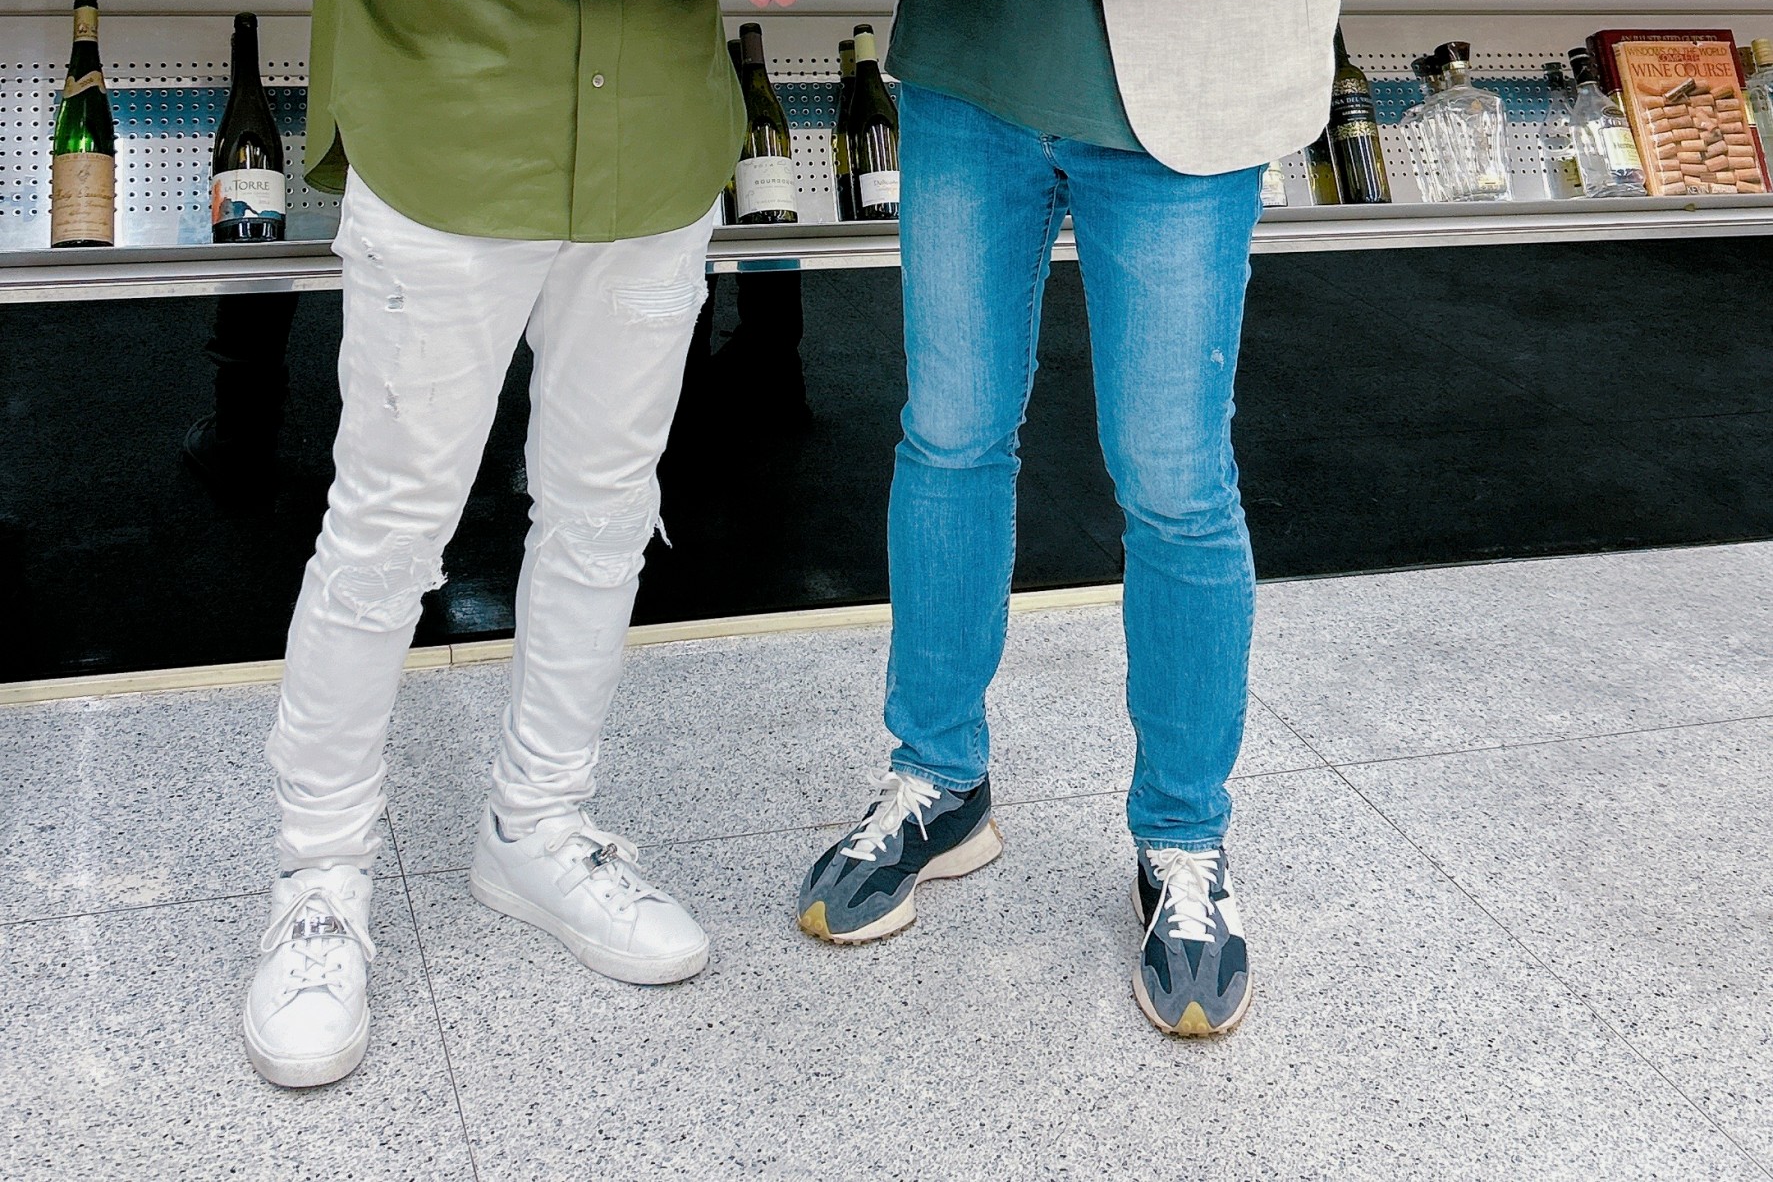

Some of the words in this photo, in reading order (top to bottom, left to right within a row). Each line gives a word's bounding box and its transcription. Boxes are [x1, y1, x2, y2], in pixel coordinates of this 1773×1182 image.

[1699, 47, 1727, 56] WORLD
[1630, 63, 1672, 78] WINE
[1674, 63, 1733, 78] COURSE
[232, 179, 270, 191] TORRE
